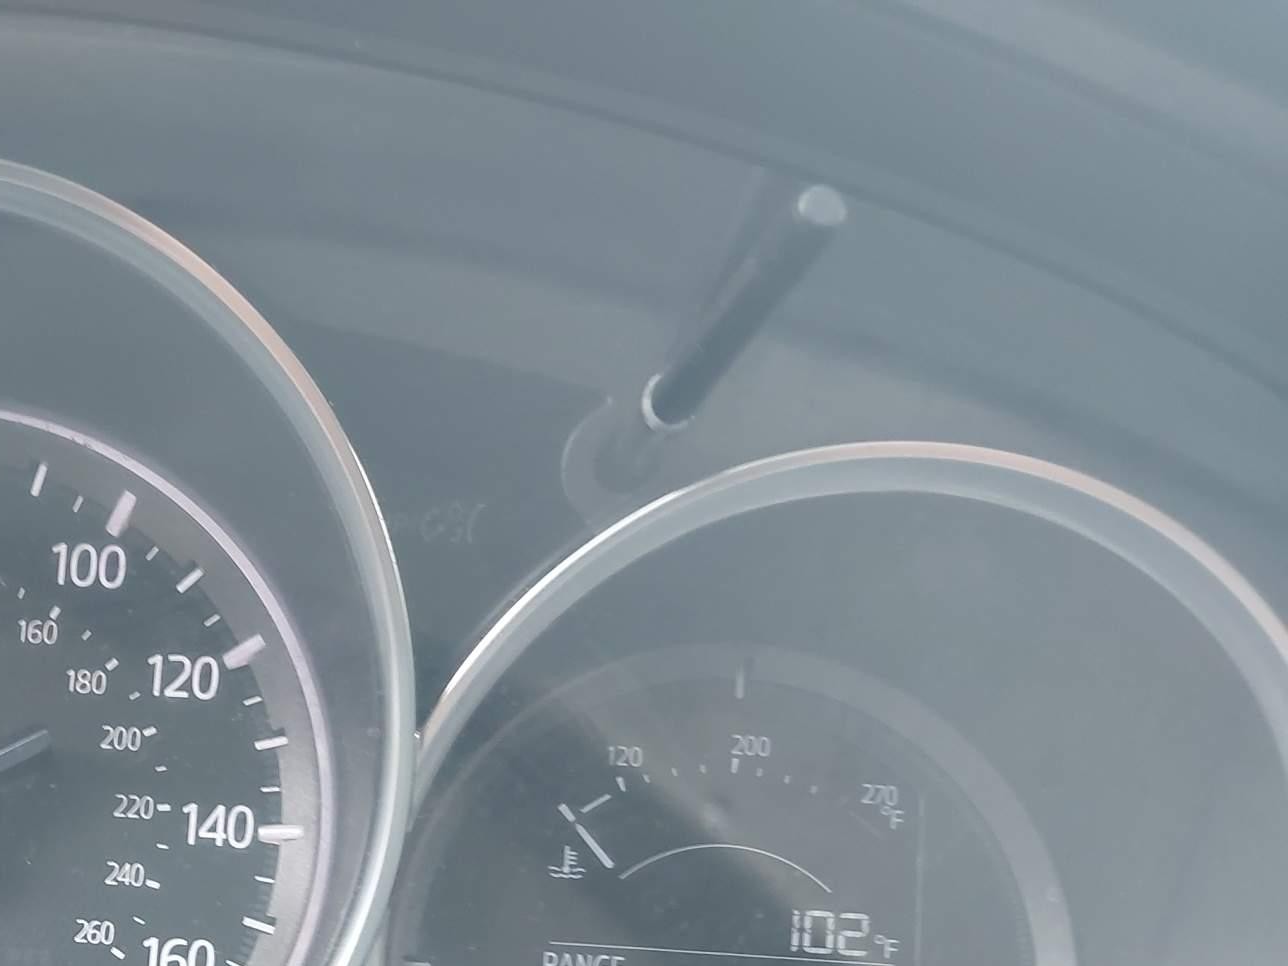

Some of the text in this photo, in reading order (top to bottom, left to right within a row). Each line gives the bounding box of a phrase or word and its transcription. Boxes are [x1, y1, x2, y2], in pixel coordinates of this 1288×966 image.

[51, 542, 126, 590] 100
[18, 619, 58, 646] 160
[67, 669, 106, 695] 180
[147, 654, 219, 701] 120
[100, 724, 142, 752] 200
[731, 735, 770, 758] 200
[609, 747, 643, 768] 120
[114, 794, 155, 820] 220
[862, 783, 898, 806] 270
[181, 802, 254, 850] 140
[105, 861, 145, 888] 240
[74, 918, 114, 945] 260
[790, 910, 870, 956] 102
